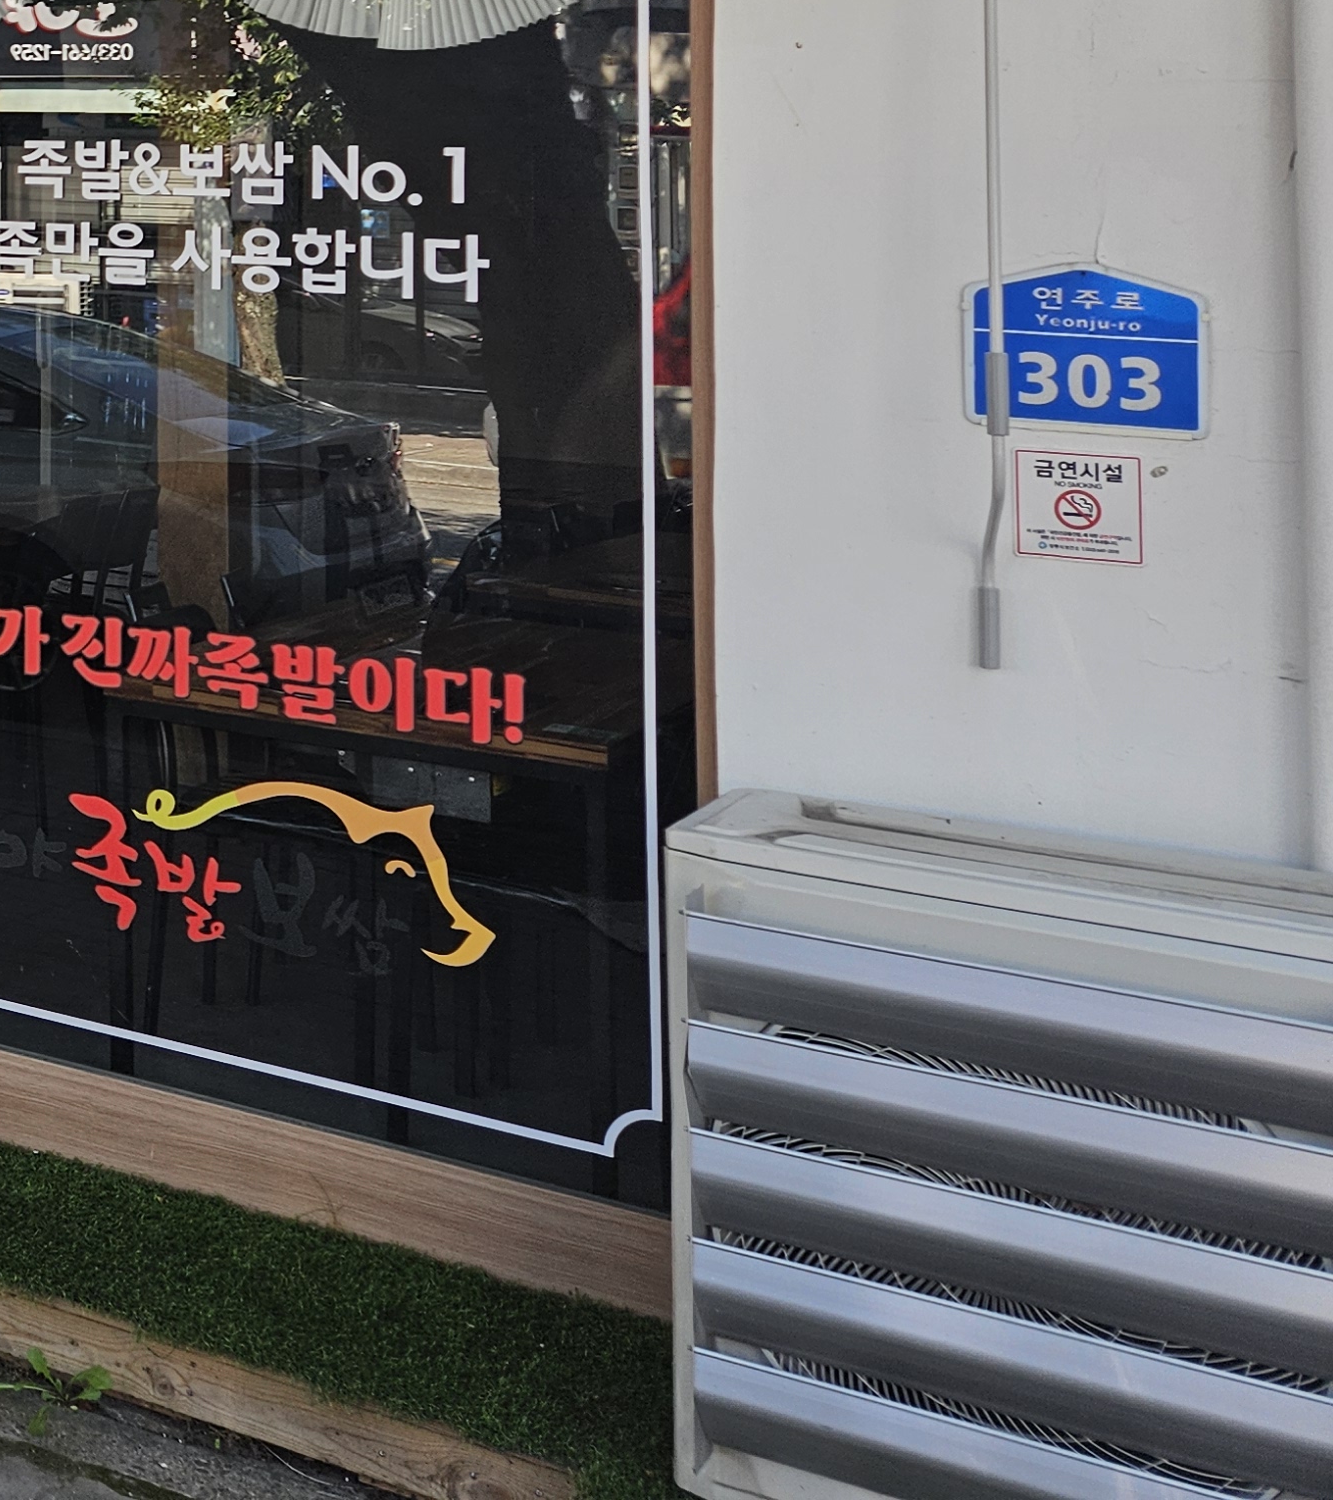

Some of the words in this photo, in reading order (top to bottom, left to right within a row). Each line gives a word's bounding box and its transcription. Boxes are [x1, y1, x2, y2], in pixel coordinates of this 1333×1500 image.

[17, 136, 294, 206] 족발&보쌈
[170, 224, 491, 305] 사용합니다
[1032, 285, 1145, 311] 연주로
[1034, 313, 1142, 332] Yeonju-ro
[1017, 351, 1163, 412] 303
[1033, 459, 1124, 483] 금연시설
[1054, 480, 1067, 488] NO
[1067, 480, 1103, 490] SMOKING
[62, 613, 527, 745] 진짜족발이다!
